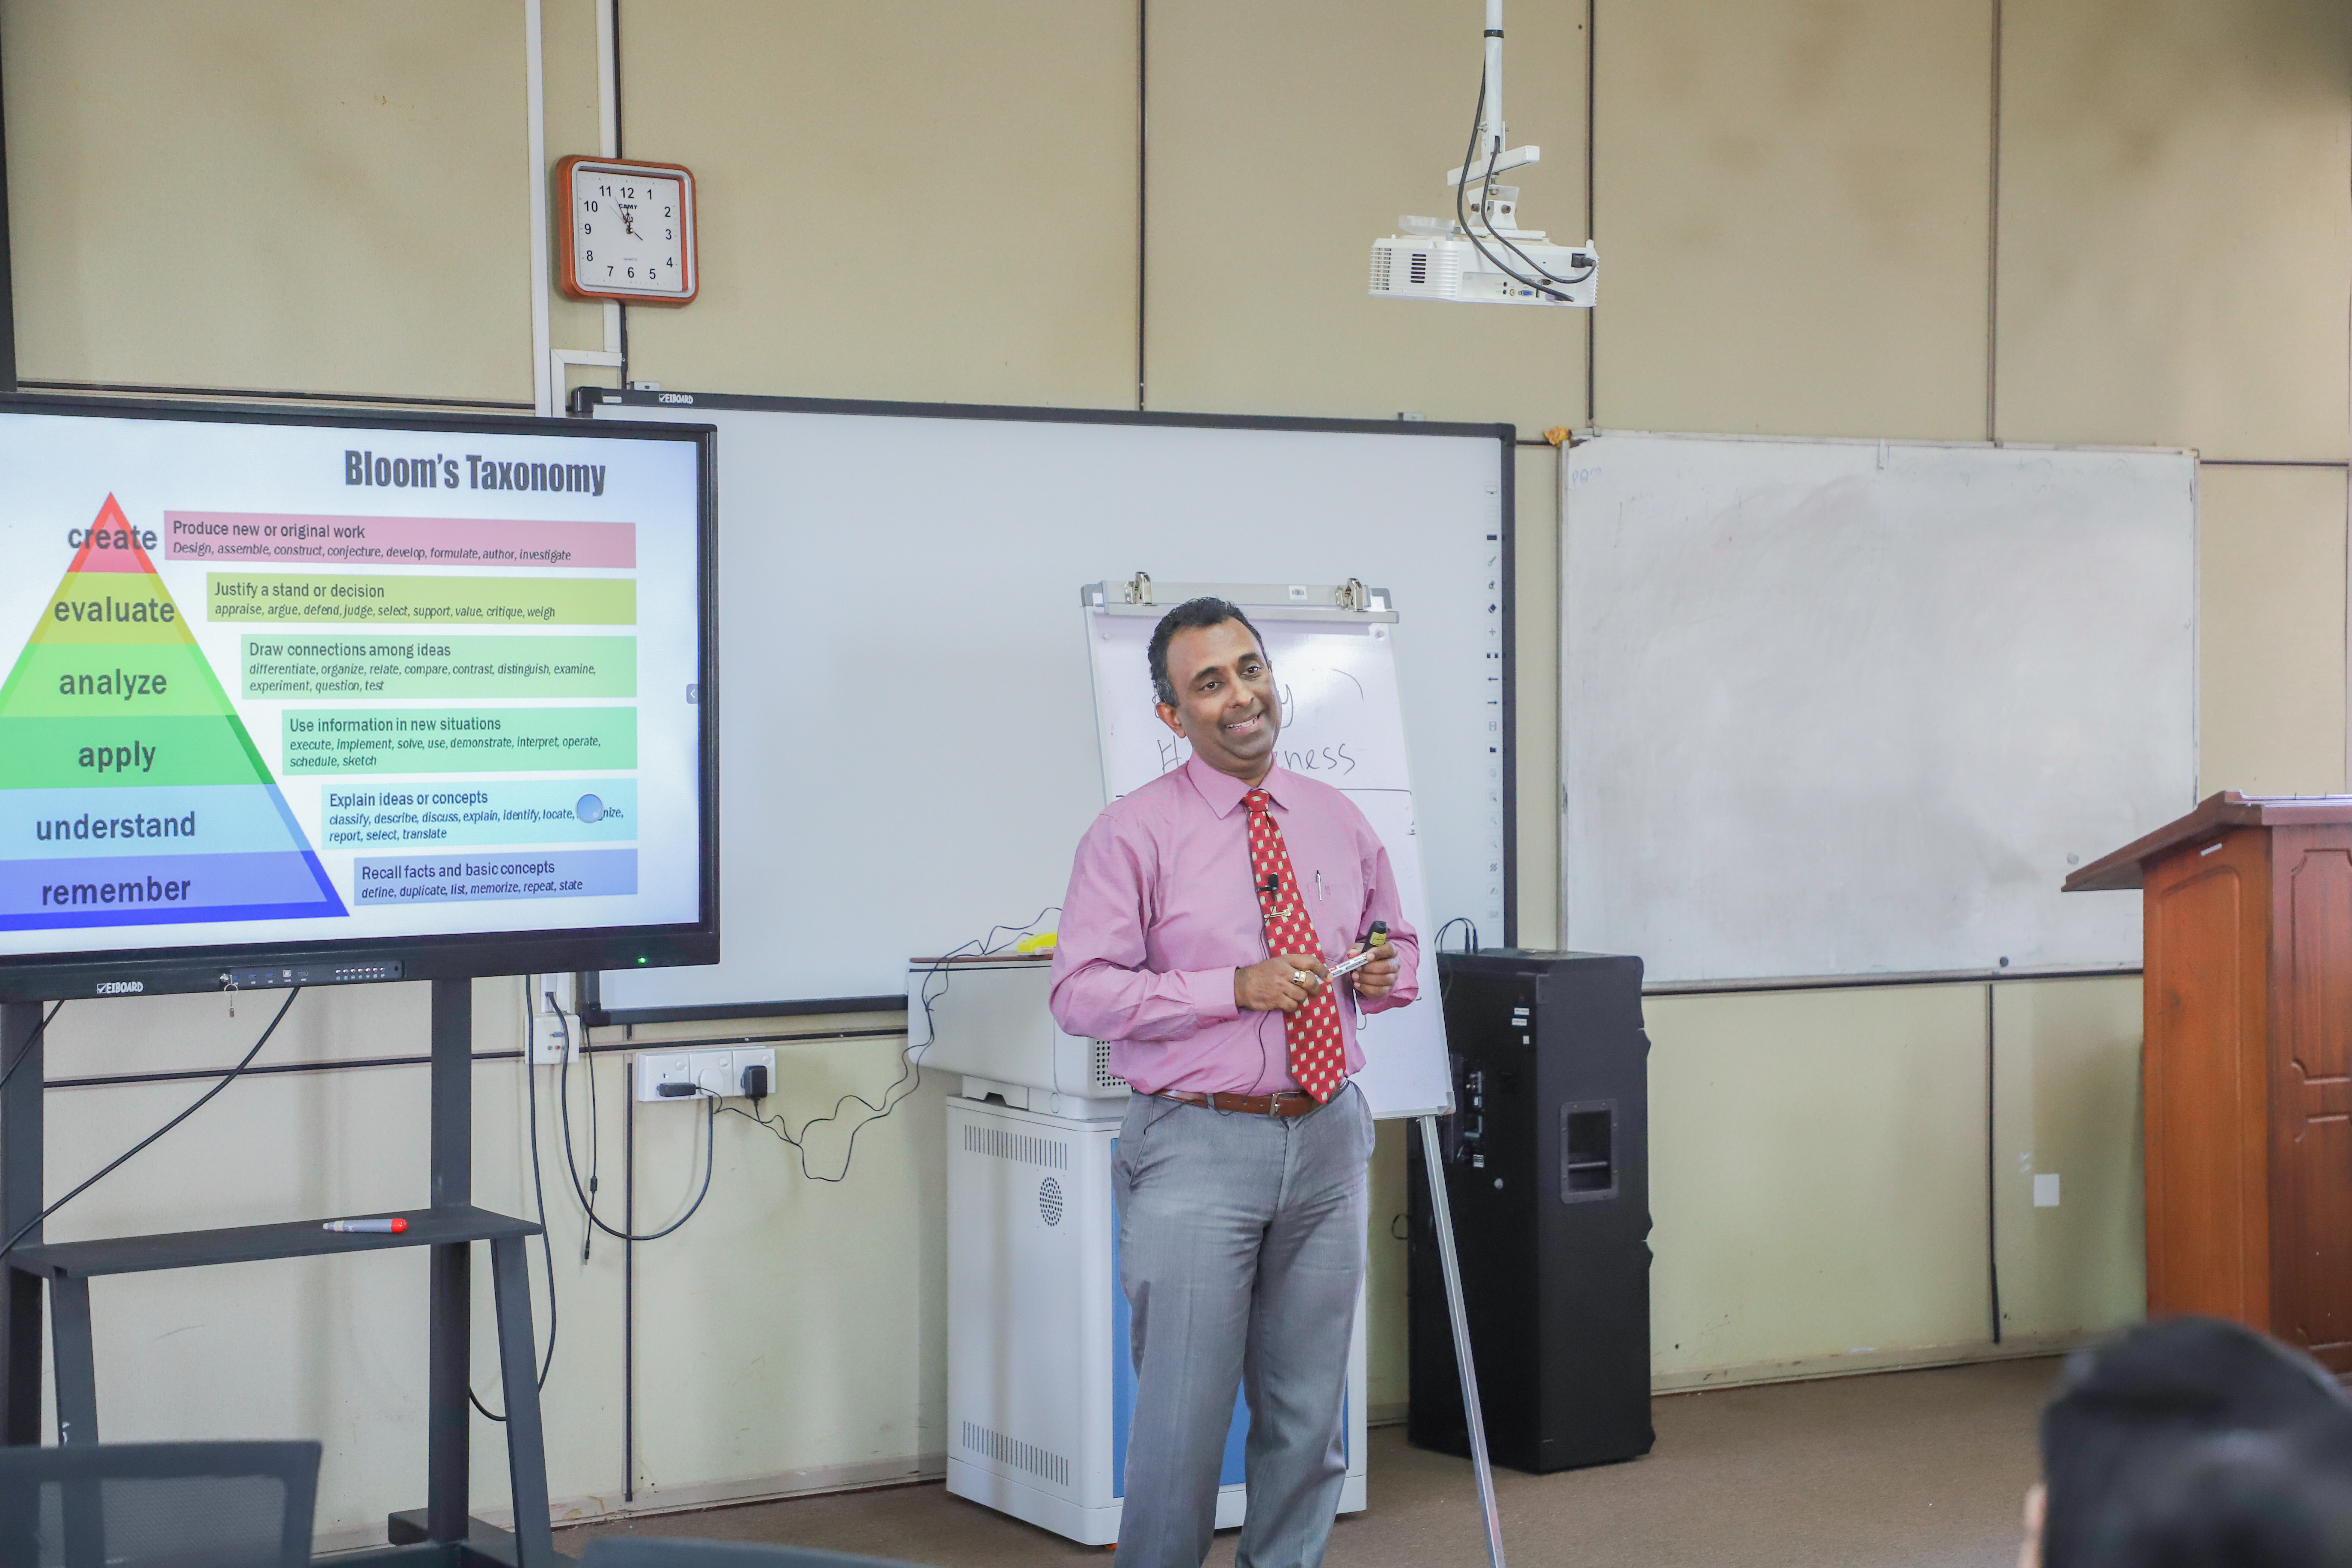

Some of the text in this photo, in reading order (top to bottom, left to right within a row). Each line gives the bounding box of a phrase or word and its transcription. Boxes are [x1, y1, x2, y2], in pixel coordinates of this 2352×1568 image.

[599, 185, 612, 197] 11
[620, 187, 635, 199] 12
[647, 189, 652, 200] 1
[584, 201, 598, 212] 10
[665, 207, 671, 217] 2
[585, 224, 591, 234] 9
[666, 229, 672, 240] 3
[587, 250, 593, 261] 8
[666, 257, 673, 268] 4
[607, 266, 614, 277] 7
[628, 267, 634, 278] 6
[649, 268, 656, 279] 5
[665, 393, 694, 404] EIBOARD
[345, 450, 606, 497] Bloom's Taxonomy
[68, 525, 157, 551] create
[173, 520, 365, 540] Produce new or original work
[173, 541, 571, 564] Design, assemble, construct, conjecture, develop, formulate, author, investigate
[214, 582, 384, 599] Justify a stand or decision
[55, 596, 175, 623] evaluate
[215, 603, 555, 621] appraise, argue, defend, judge, select, support, value, critique, weigh
[250, 642, 451, 659] Draw connections among ideas
[249, 663, 596, 678] differentiate, organize, relate, compare, contrast, distinguish, examine,
[60, 668, 167, 700] analyze
[249, 679, 384, 695] experiment, question, test
[290, 717, 501, 732] Use information in new situations
[290, 739, 334, 752] execute,
[397, 738, 425, 750] solve,
[427, 739, 448, 750] use,
[450, 737, 514, 749] demonstrate,
[517, 736, 560, 750] interpret,
[562, 736, 601, 750] operate,
[78, 740, 156, 773] apply
[289, 755, 377, 768] schedule, sketch
[330, 790, 488, 810] Explain ideas or concepts
[37, 811, 196, 841] understand
[329, 813, 371, 828] classify,
[374, 812, 419, 825] describe,
[422, 811, 461, 823] discuss,
[462, 810, 501, 825] explain,
[503, 808, 541, 823] identify,
[542, 808, 575, 820] locate,
[329, 828, 447, 844] report, select, translate
[362, 860, 555, 880] Recall facts and basic concepts
[43, 876, 191, 906] remember
[361, 880, 583, 899] define, duplicate, list, memorize, repeat, state
[106, 981, 144, 994] EIBOARD
